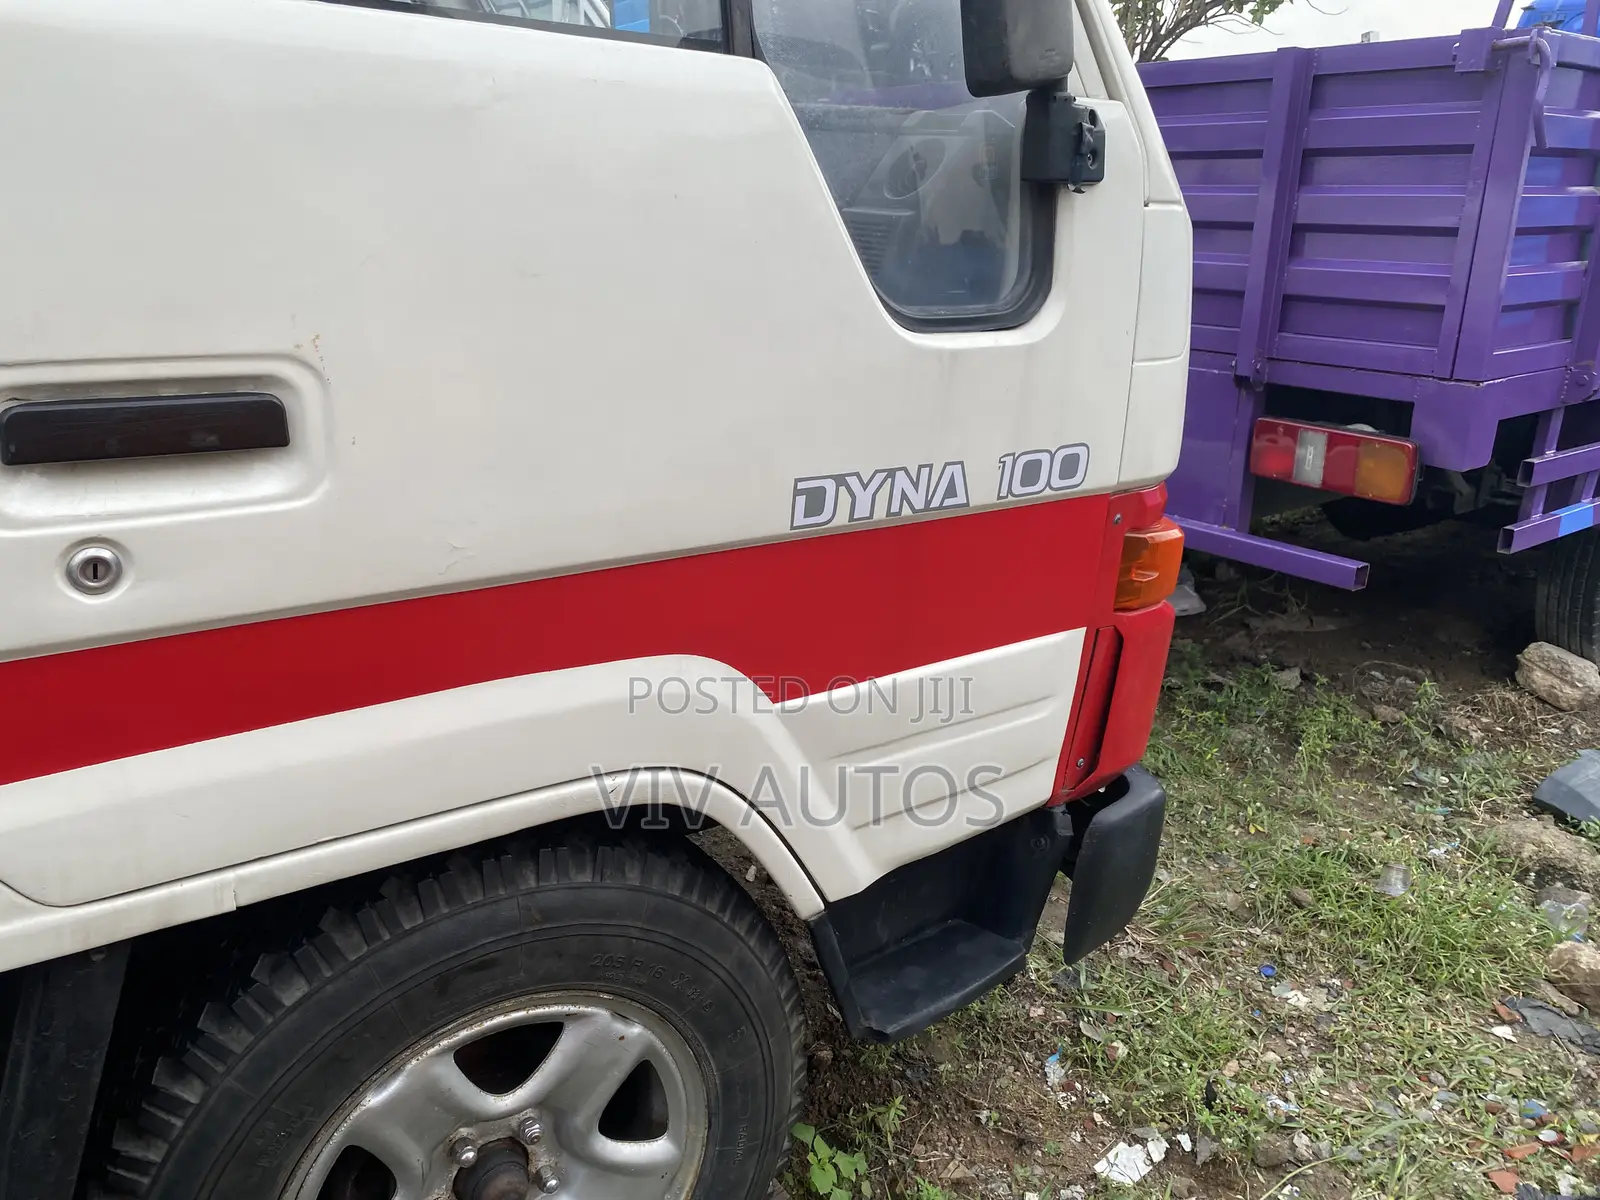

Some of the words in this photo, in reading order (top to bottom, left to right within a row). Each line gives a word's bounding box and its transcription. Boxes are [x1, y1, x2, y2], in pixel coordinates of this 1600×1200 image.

[790, 461, 970, 530] DYNA
[996, 442, 1090, 501] 100
[588, 953, 626, 969] 205
